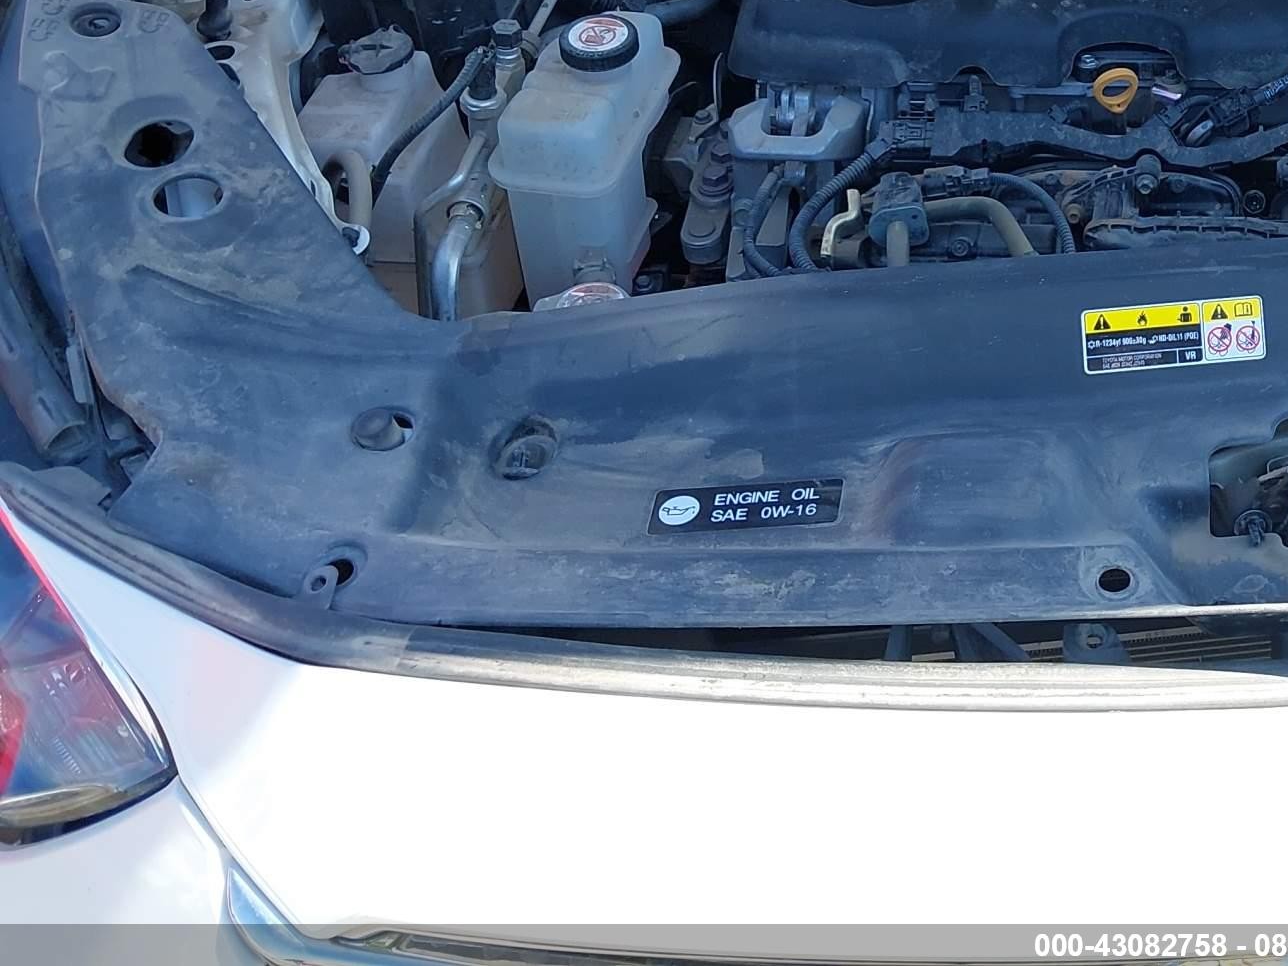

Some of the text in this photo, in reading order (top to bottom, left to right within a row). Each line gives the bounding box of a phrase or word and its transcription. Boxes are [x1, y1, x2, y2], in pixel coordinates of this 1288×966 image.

[1184, 351, 1197, 360] VR
[713, 487, 820, 506] ENGINE OIL
[710, 503, 817, 523] SAE 0W-16
